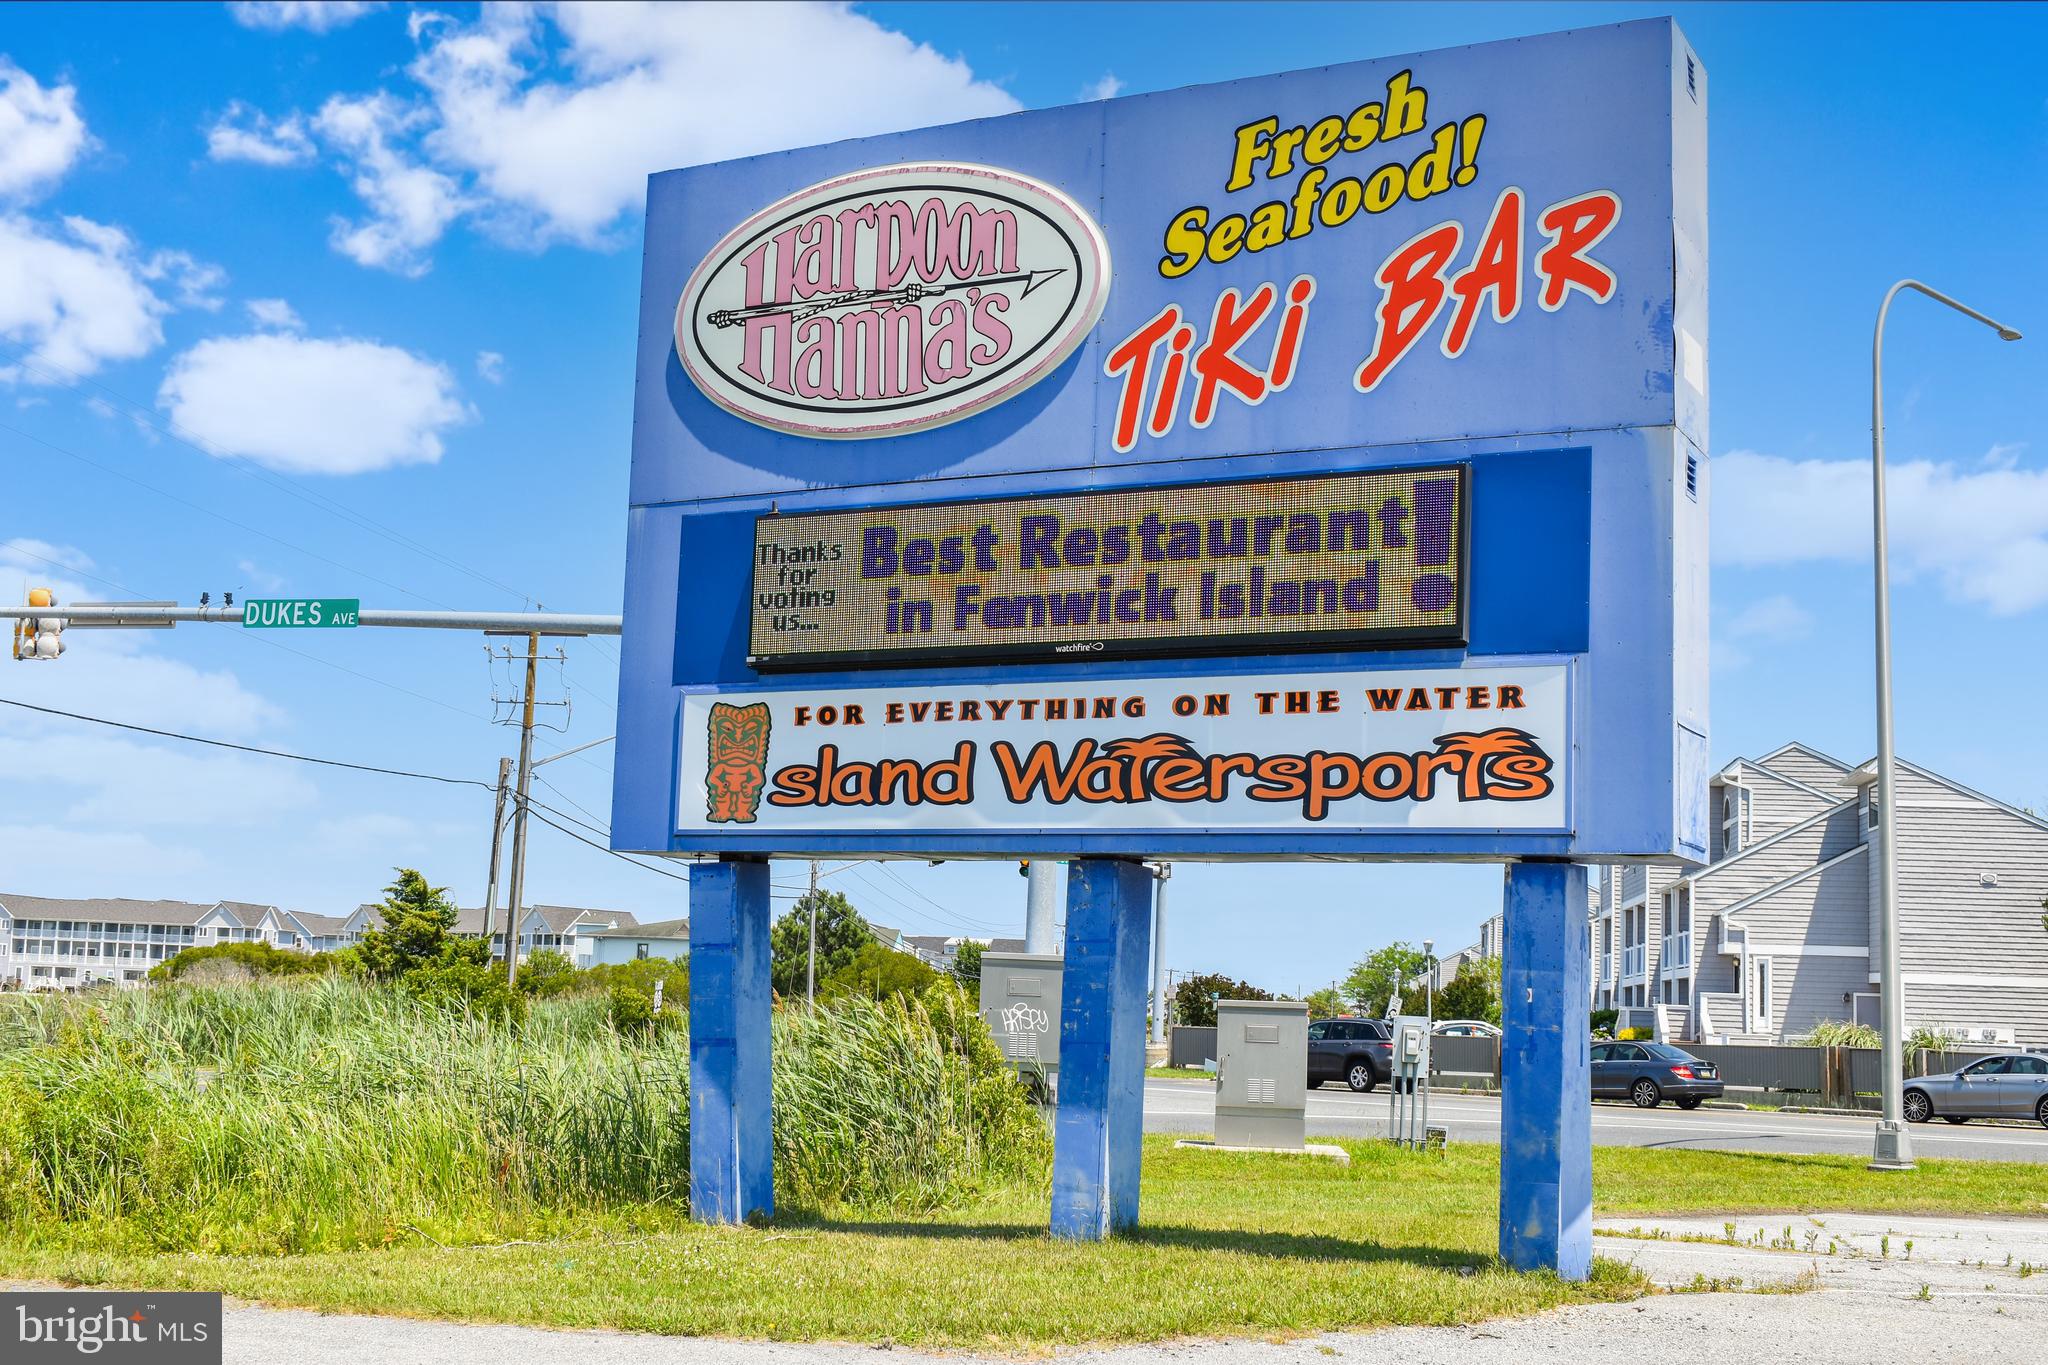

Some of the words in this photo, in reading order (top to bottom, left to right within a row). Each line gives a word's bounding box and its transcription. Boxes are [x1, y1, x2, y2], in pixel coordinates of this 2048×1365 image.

[1225, 69, 1428, 193] Fresh
[1158, 113, 1487, 279] Seafood!
[741, 197, 1019, 306] Harpoon
[1352, 186, 1622, 393] BAR
[738, 288, 1013, 400] Hanna's
[758, 541, 842, 565] Thanks
[861, 524, 999, 579] Best
[758, 587, 836, 610] voting
[778, 566, 817, 586] for
[885, 586, 933, 634] in
[954, 573, 1178, 632] Fenwick
[1200, 559, 1380, 620] Island
[245, 602, 322, 626] DUKES
[332, 612, 356, 625] AVE
[772, 614, 819, 632] us...
[1055, 642, 1090, 653] watchfire
[794, 704, 866, 726] FOR
[885, 695, 1146, 726] EVERYTHING
[1172, 694, 1230, 717] ON
[1255, 690, 1340, 715] THE
[1365, 684, 1527, 712] WATER
